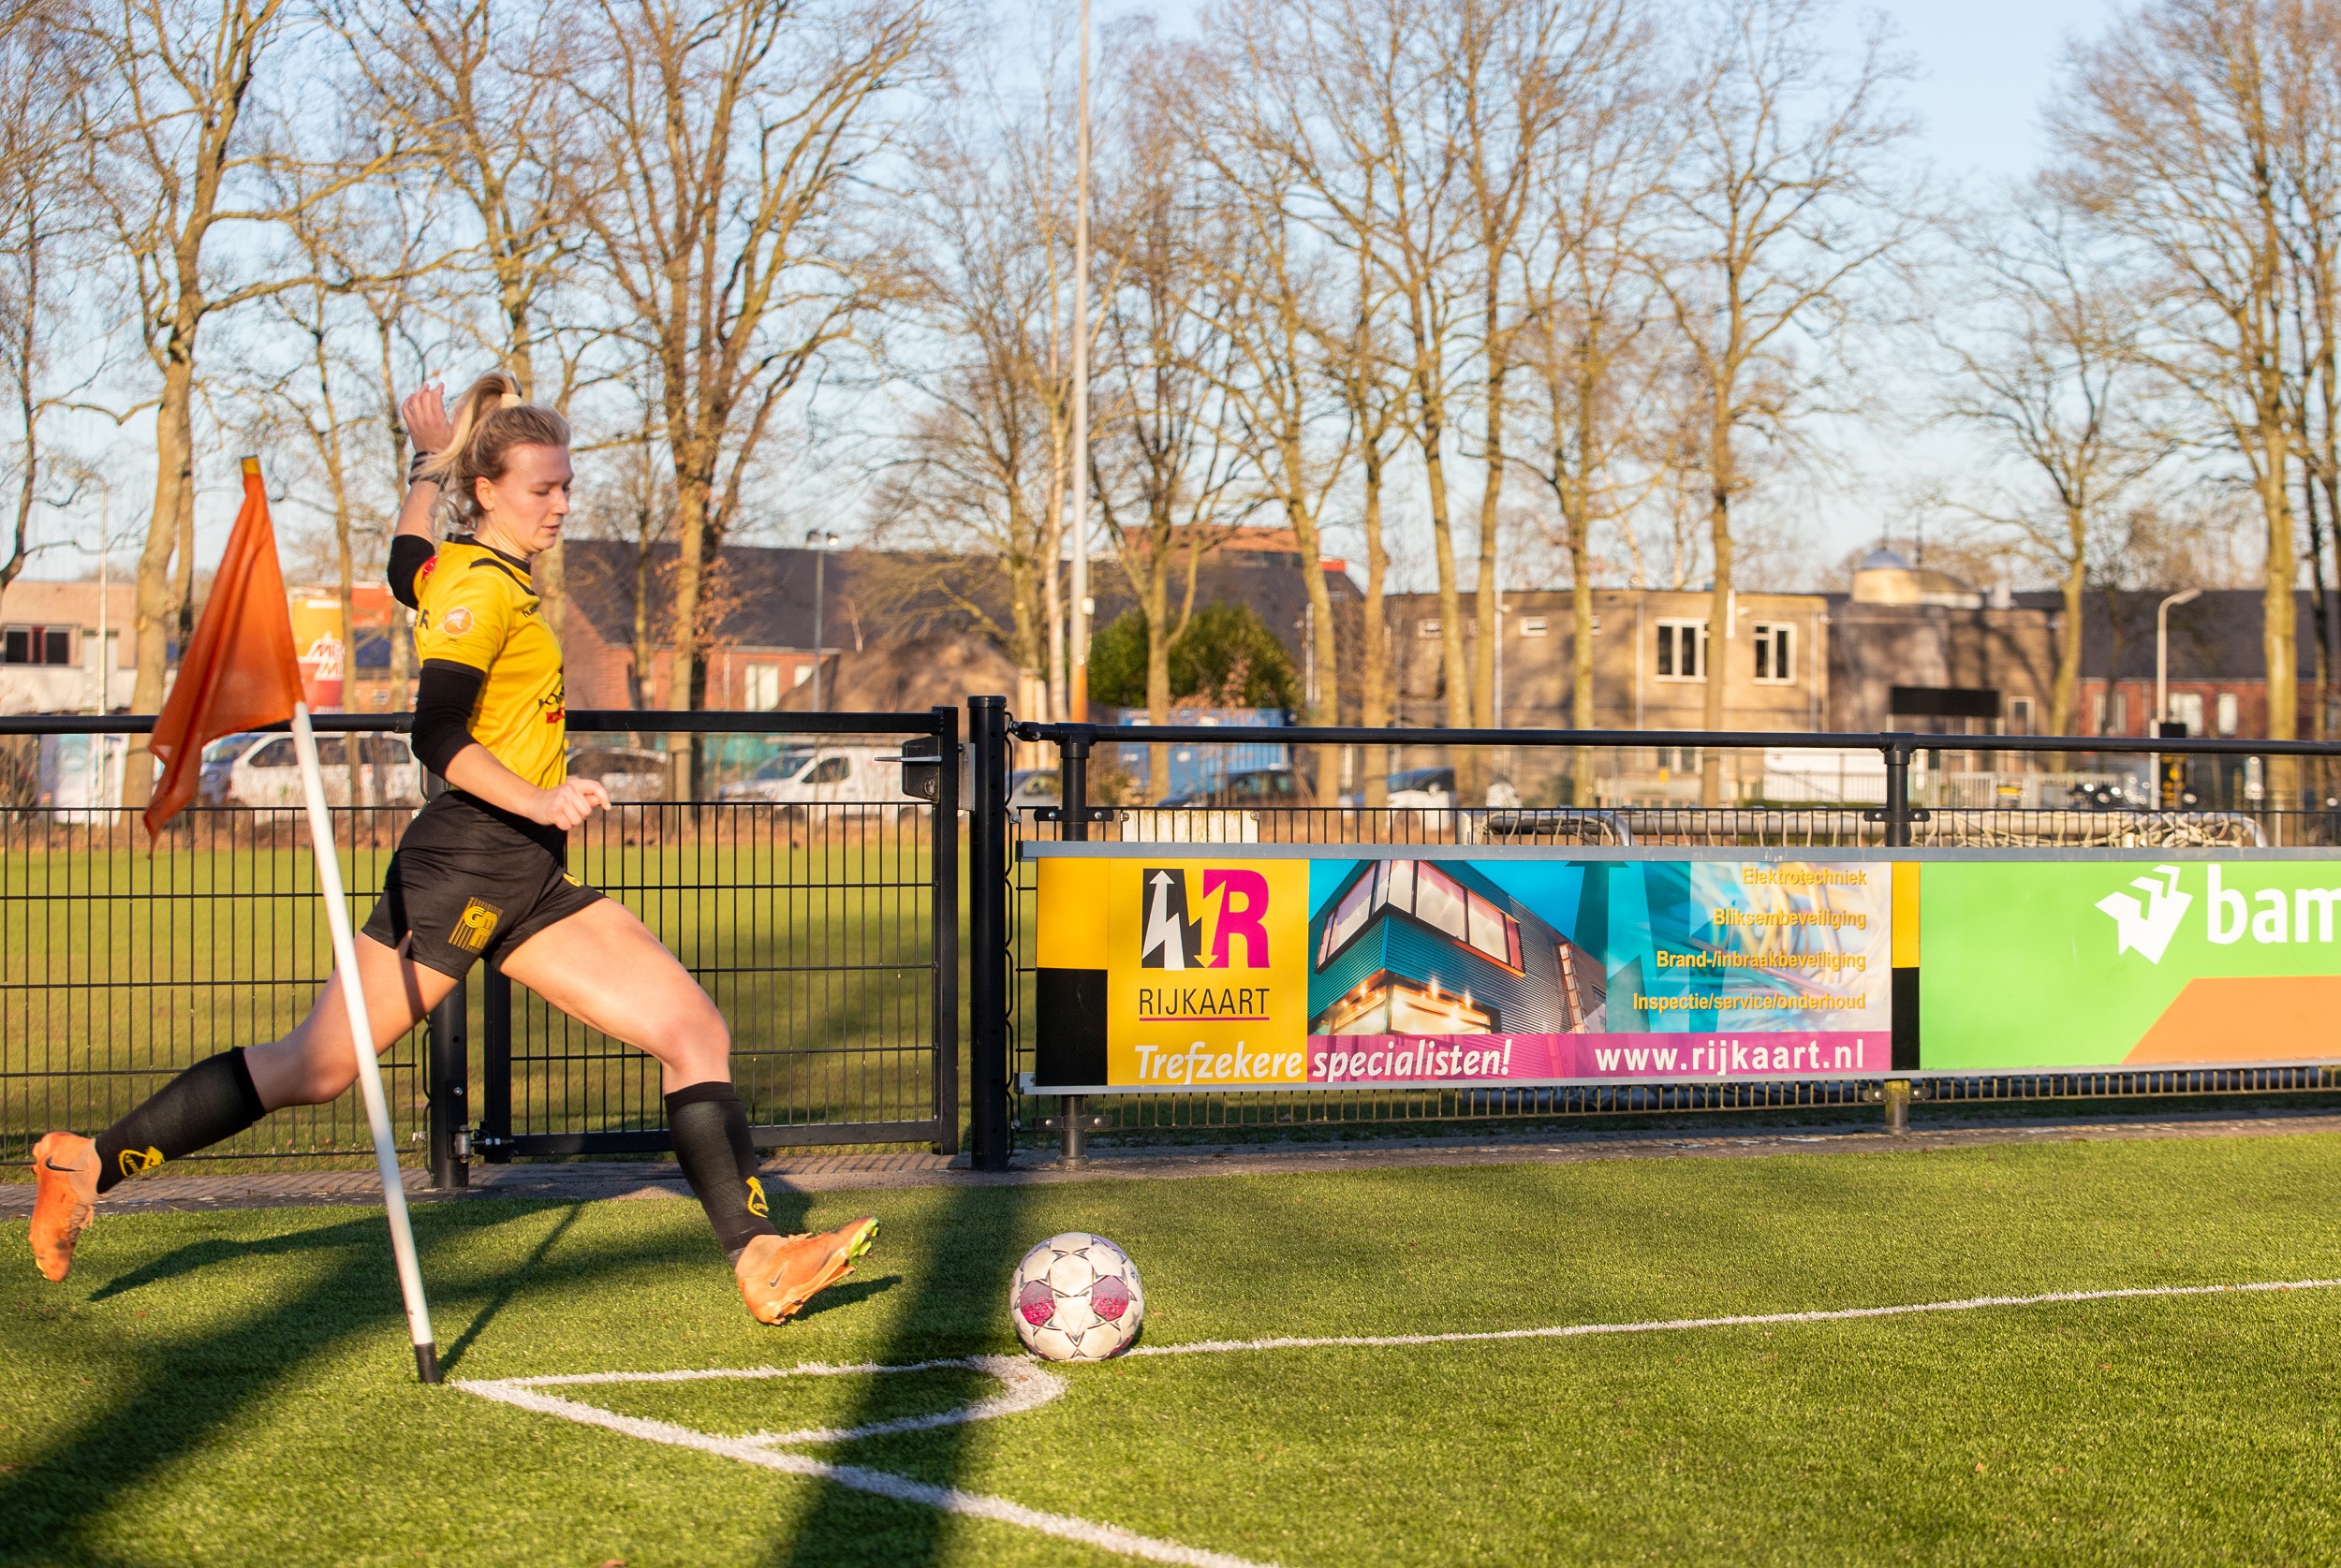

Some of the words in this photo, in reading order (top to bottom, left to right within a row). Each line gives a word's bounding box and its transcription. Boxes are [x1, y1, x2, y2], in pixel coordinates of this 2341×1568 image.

[1742, 866, 1867, 886] Elektrotechniek
[1713, 907, 1866, 931] Bliksembeveiliging
[1656, 949, 1866, 972] Brand-/inbraakbeveiliging
[1139, 988, 1271, 1015] RIJKAART
[1633, 992, 1866, 1014] Inspectie/service/onderhoud
[1134, 1040, 1303, 1085] Trefzekere
[1312, 1038, 1512, 1082] specialisten!
[1595, 1038, 1864, 1076] www.rijkaart.nl
